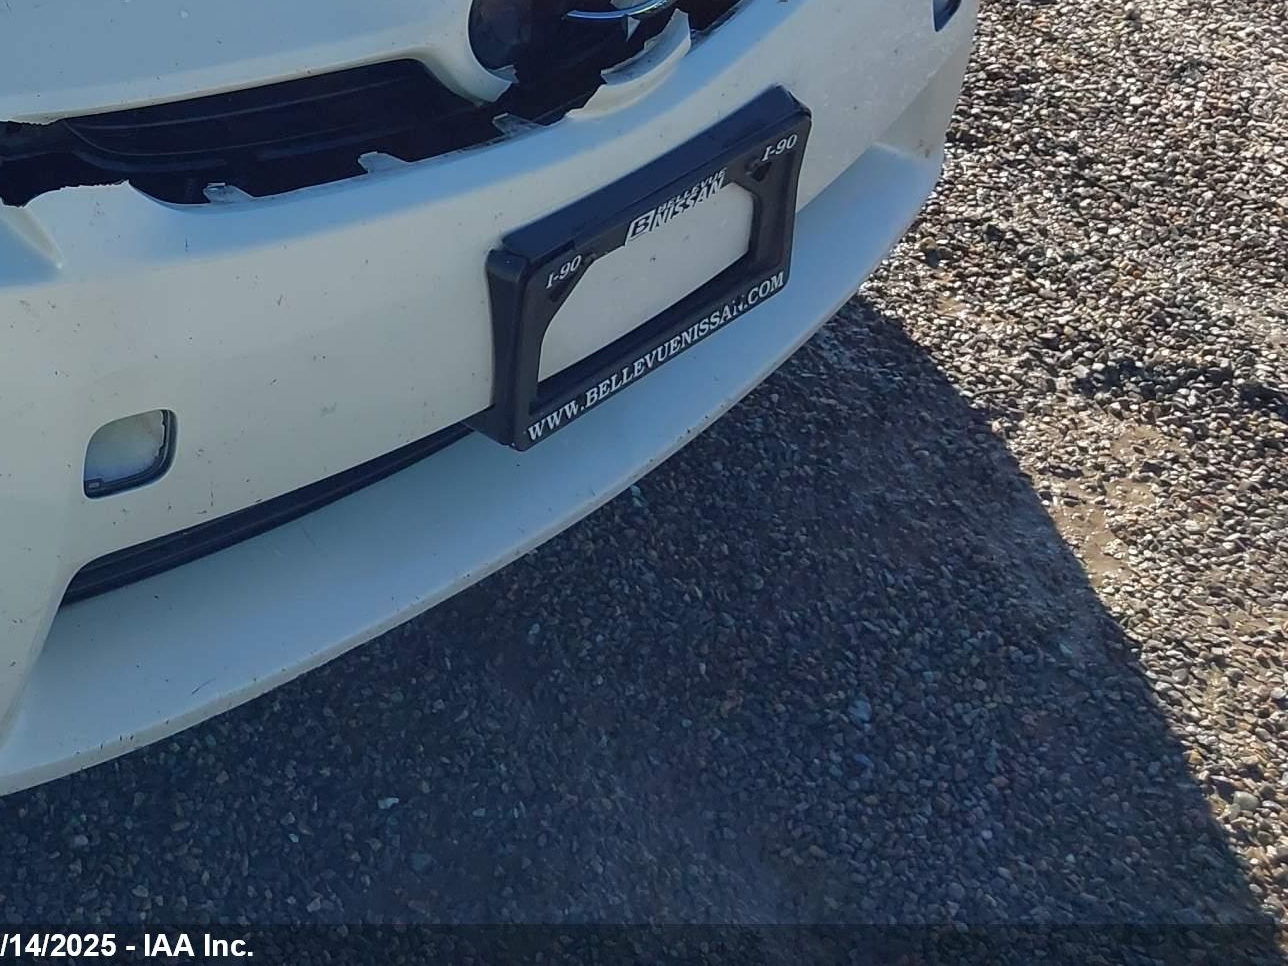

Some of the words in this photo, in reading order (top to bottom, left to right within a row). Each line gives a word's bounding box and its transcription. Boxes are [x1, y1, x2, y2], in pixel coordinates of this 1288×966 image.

[761, 134, 798, 162] I-90
[652, 176, 725, 232] NISSAN
[545, 255, 583, 289] I-90
